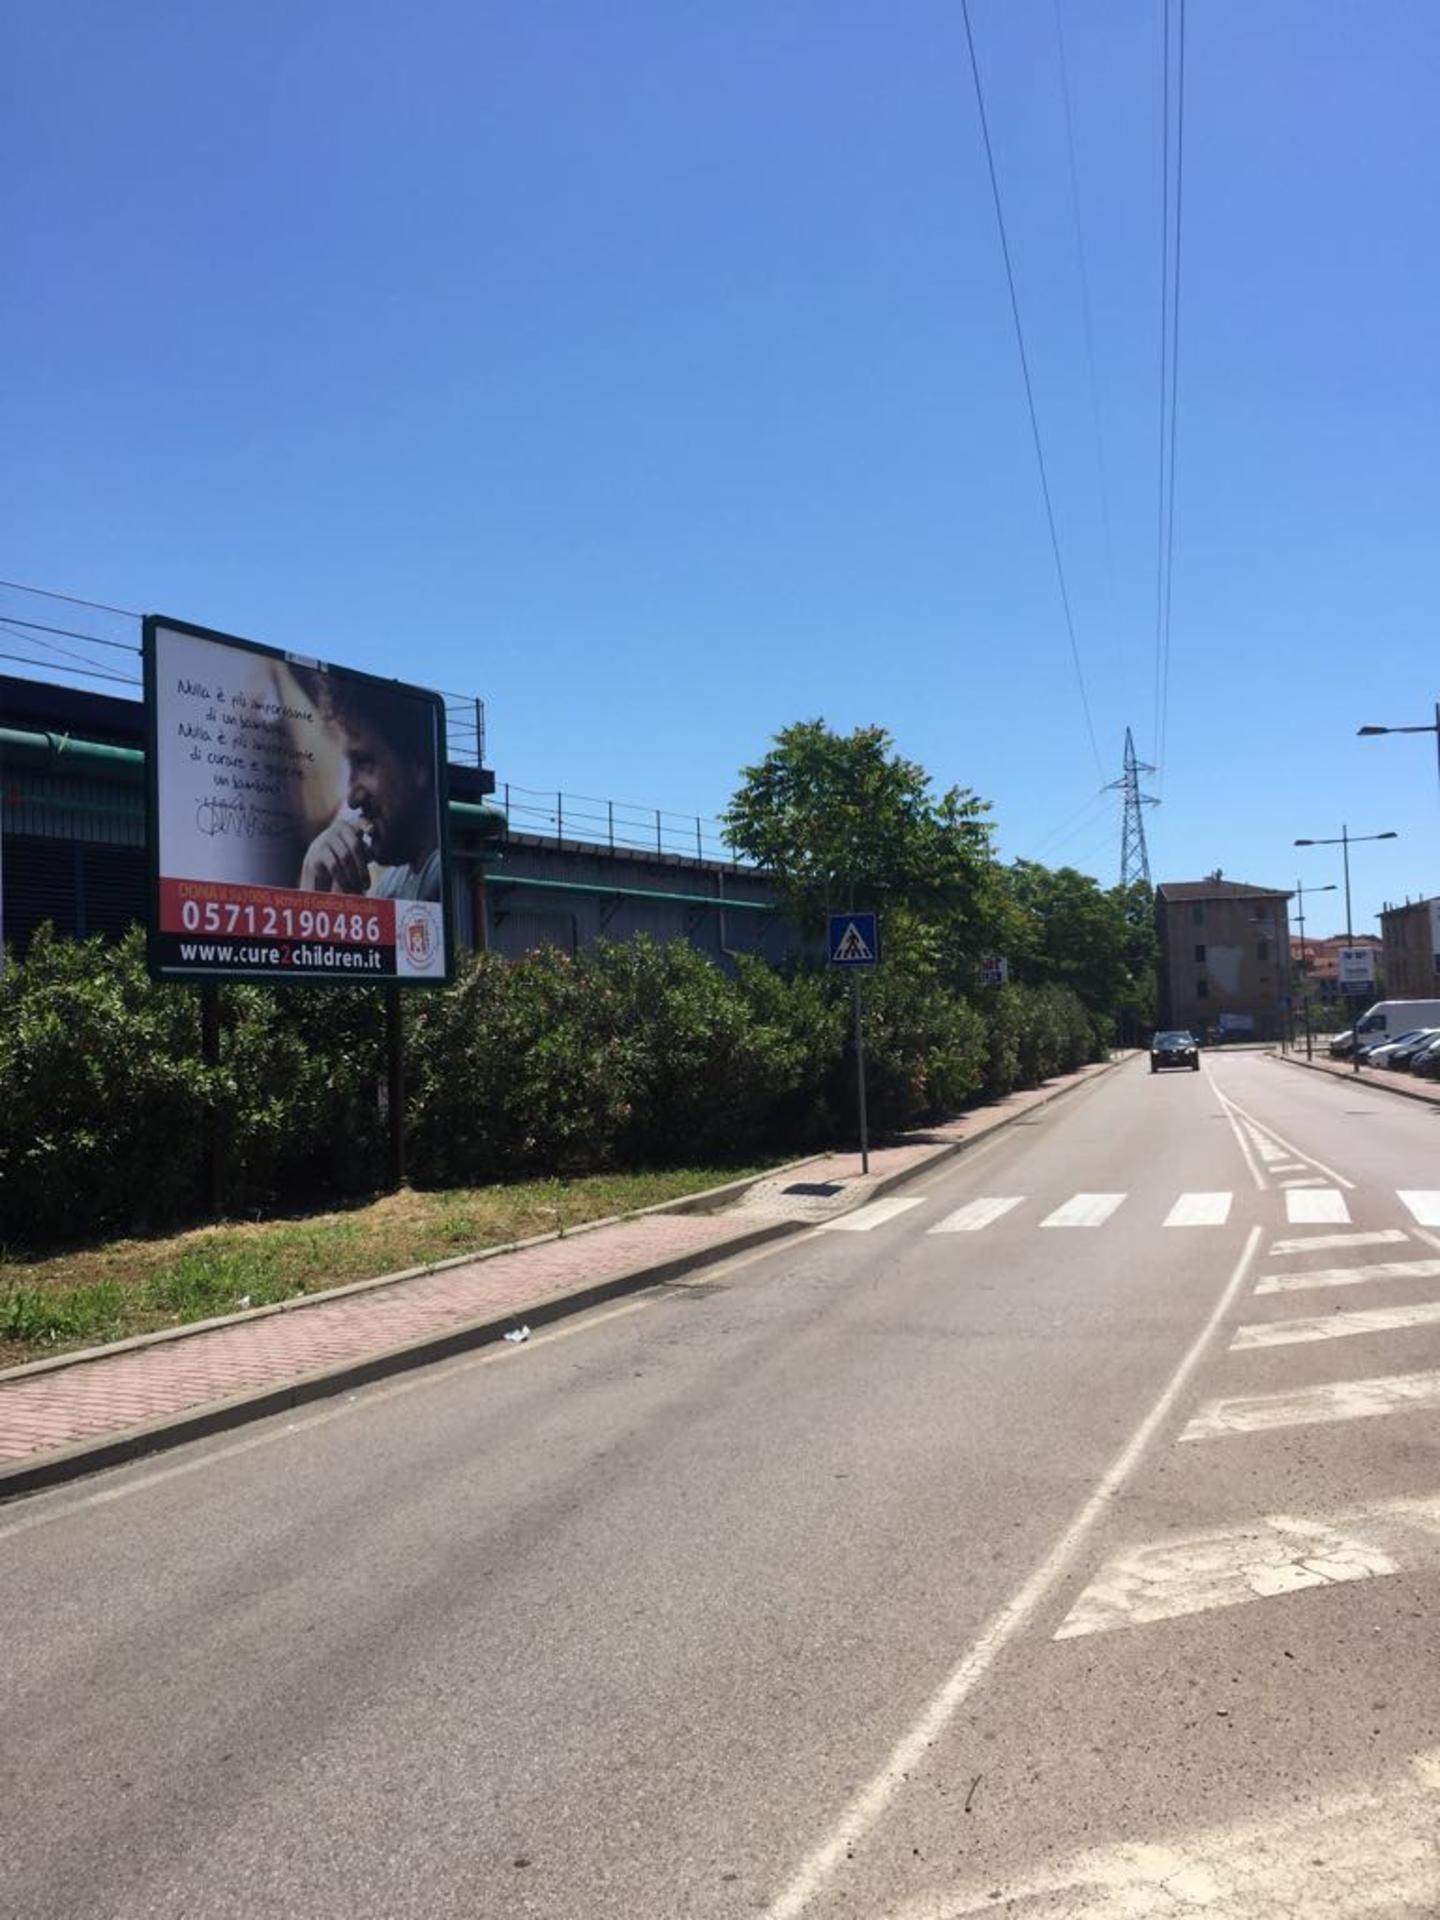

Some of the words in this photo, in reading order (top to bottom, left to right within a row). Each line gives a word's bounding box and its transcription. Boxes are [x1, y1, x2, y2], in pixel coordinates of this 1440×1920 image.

[205, 706, 217, 722] di
[189, 745, 202, 761] di
[251, 740, 316, 762] imante
[181, 901, 381, 942] 05712190486
[180, 944, 382, 969] www.cure2children.it
